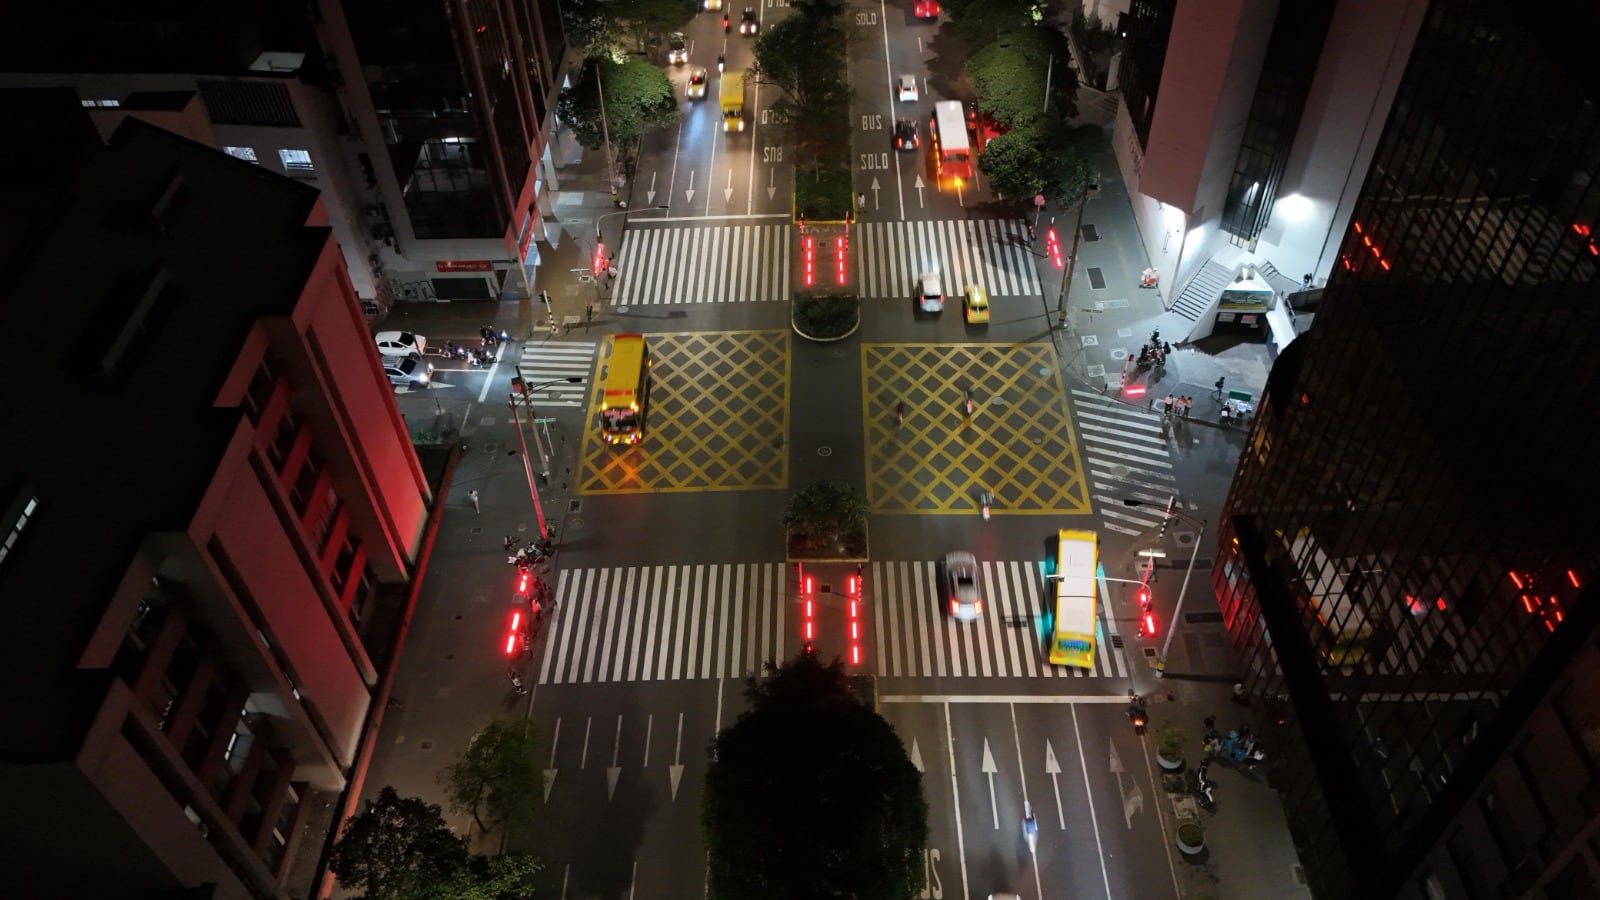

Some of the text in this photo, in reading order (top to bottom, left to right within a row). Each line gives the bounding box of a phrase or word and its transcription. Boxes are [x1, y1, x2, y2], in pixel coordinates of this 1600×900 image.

[855, 12, 877, 25] SOLO
[862, 115, 882, 131] BUS
[763, 146, 783, 163] BUS
[860, 152, 889, 170] SOLO
[905, 848, 943, 900] US
